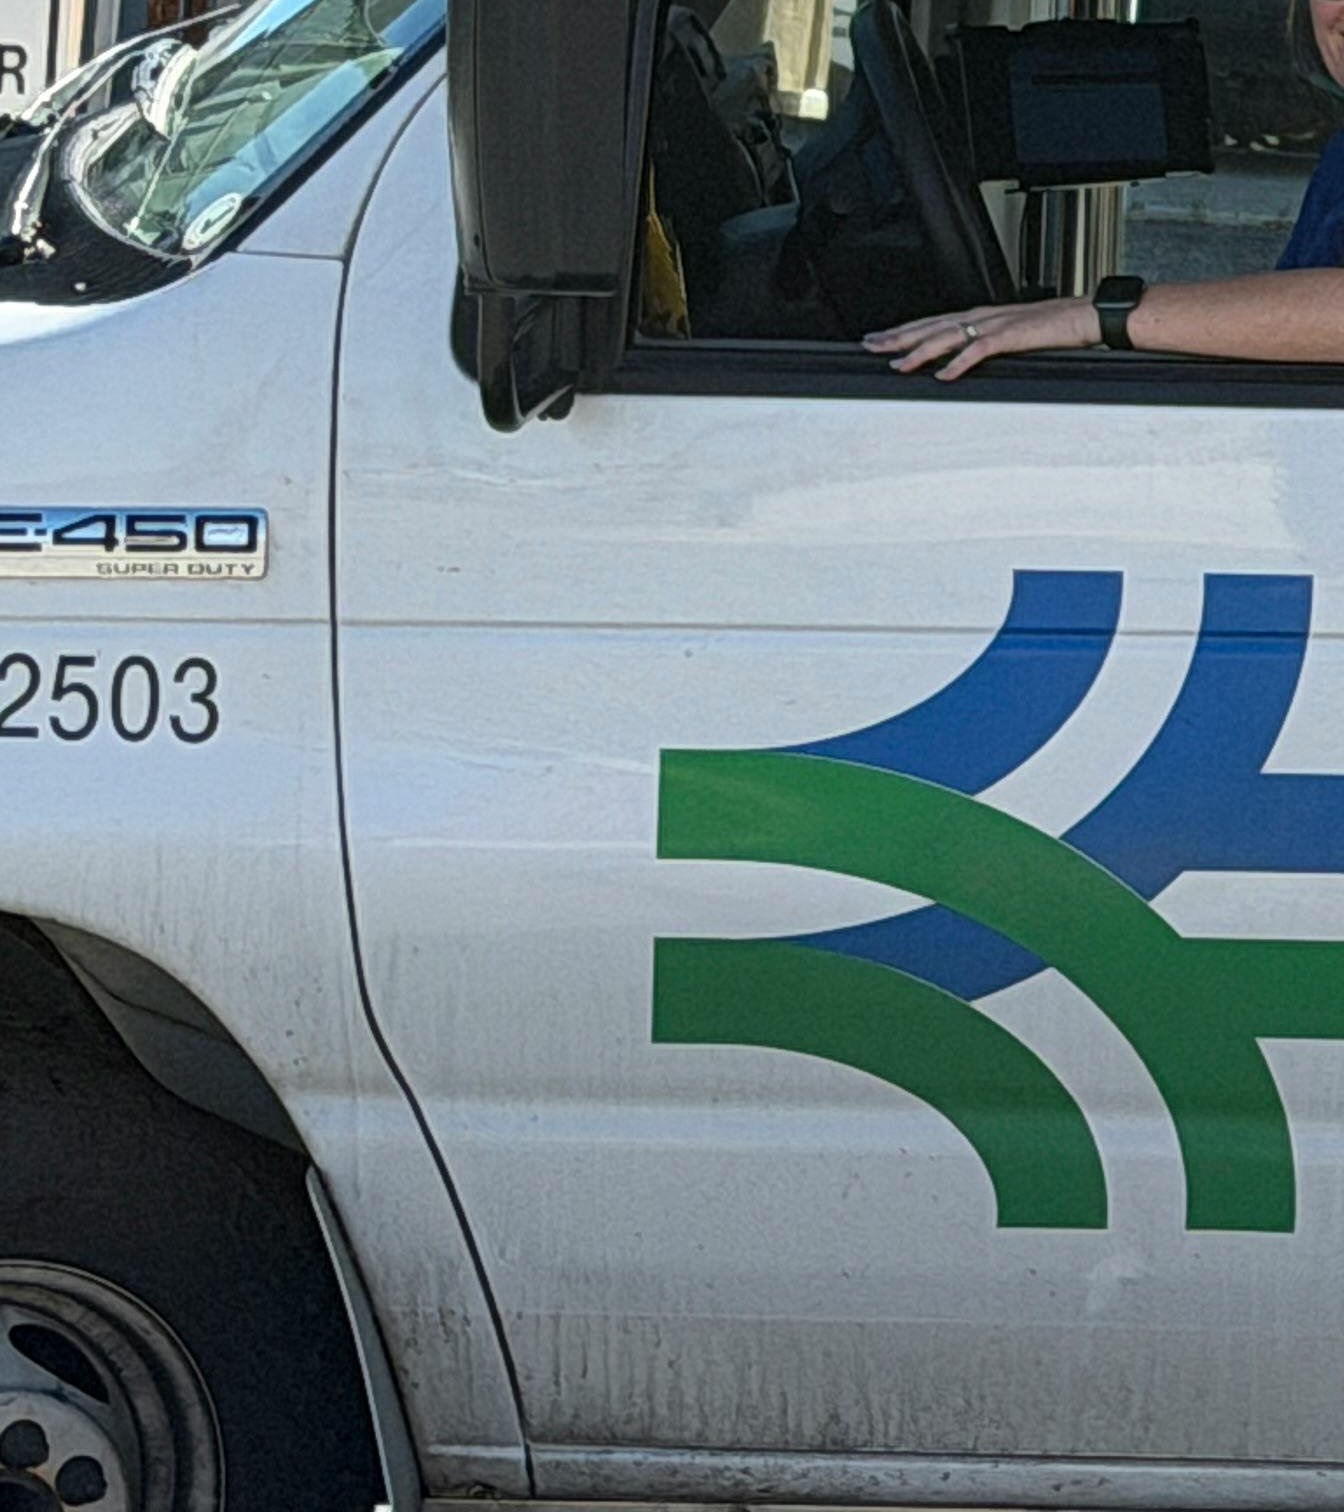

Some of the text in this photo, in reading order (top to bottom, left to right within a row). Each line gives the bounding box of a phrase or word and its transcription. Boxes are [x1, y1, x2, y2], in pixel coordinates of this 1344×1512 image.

[96, 562, 256, 576] SUPER DUTY
[0, 652, 220, 744] 2503
